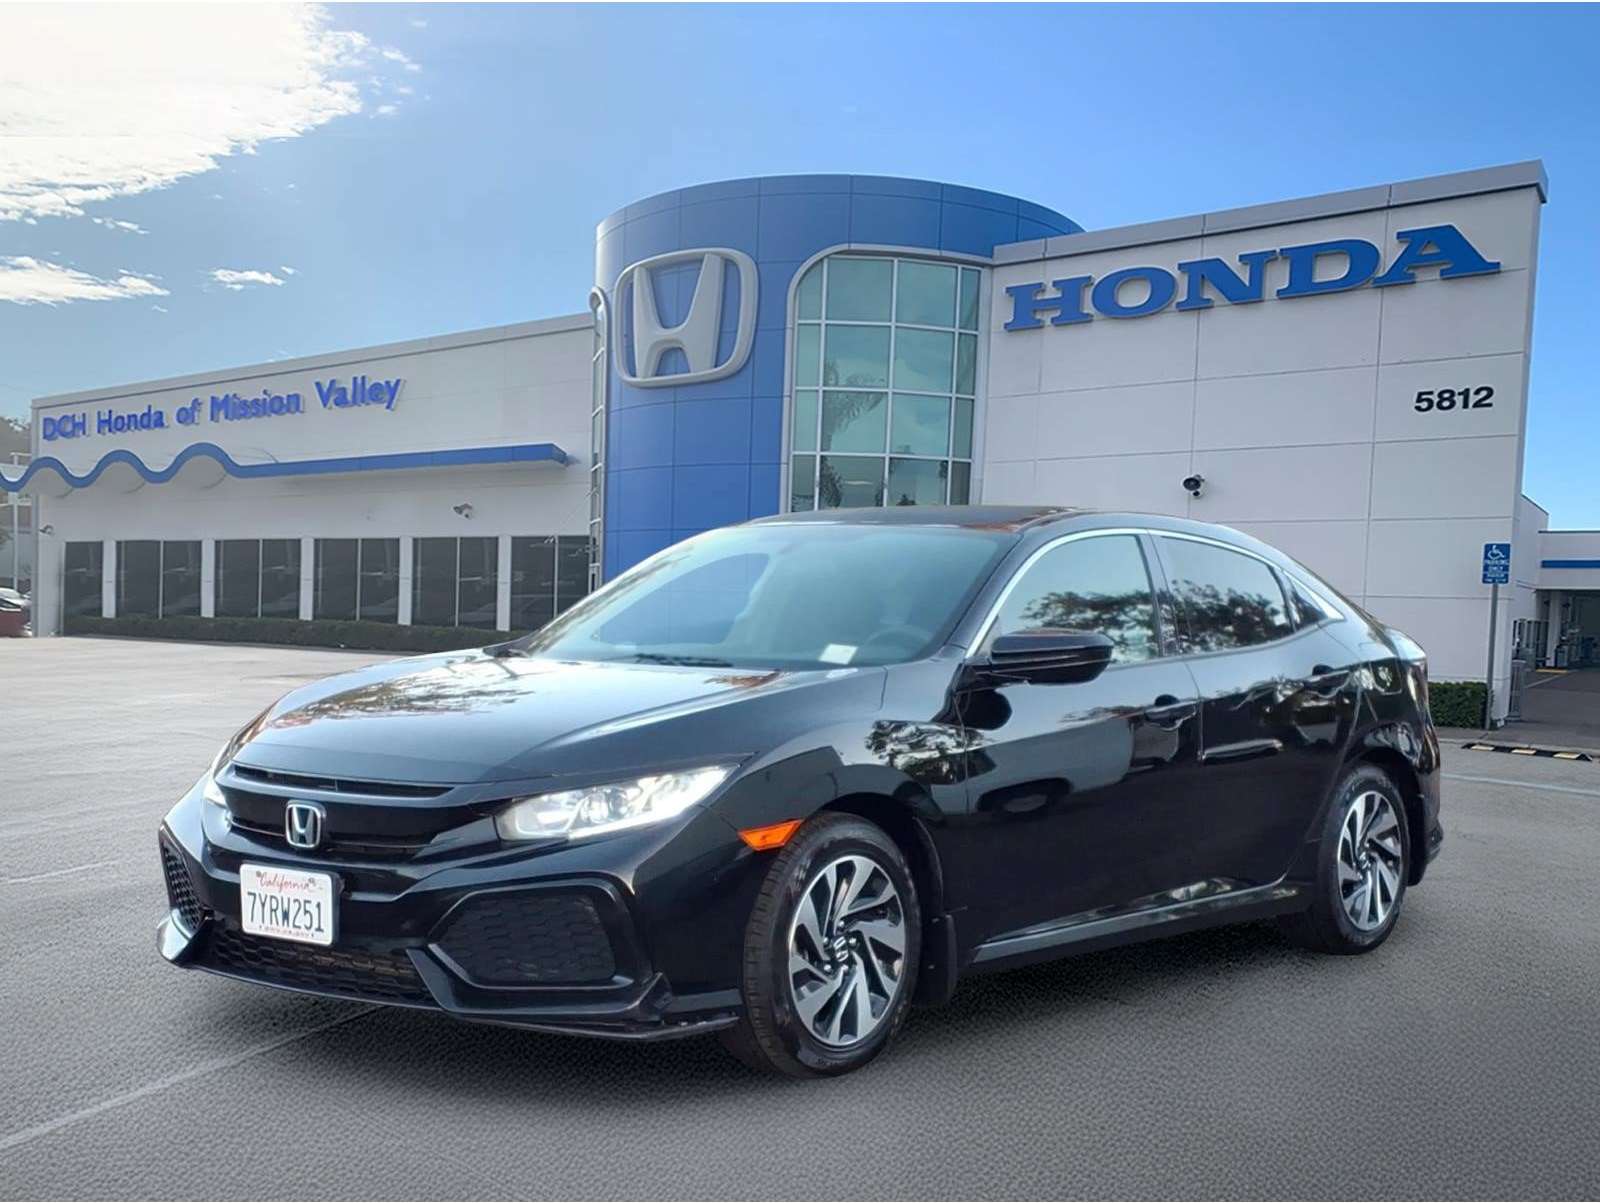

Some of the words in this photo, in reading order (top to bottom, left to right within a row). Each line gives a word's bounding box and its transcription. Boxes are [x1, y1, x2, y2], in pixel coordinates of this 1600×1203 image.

[1004, 224, 1501, 331] HONDA
[42, 412, 87, 441] DCH
[97, 403, 165, 436] Honda
[175, 398, 202, 426] of
[209, 388, 303, 423] Mission
[314, 375, 404, 411] Valley
[1414, 385, 1494, 412] 5812
[258, 871, 310, 893] California
[247, 891, 324, 933] 7YRW251
